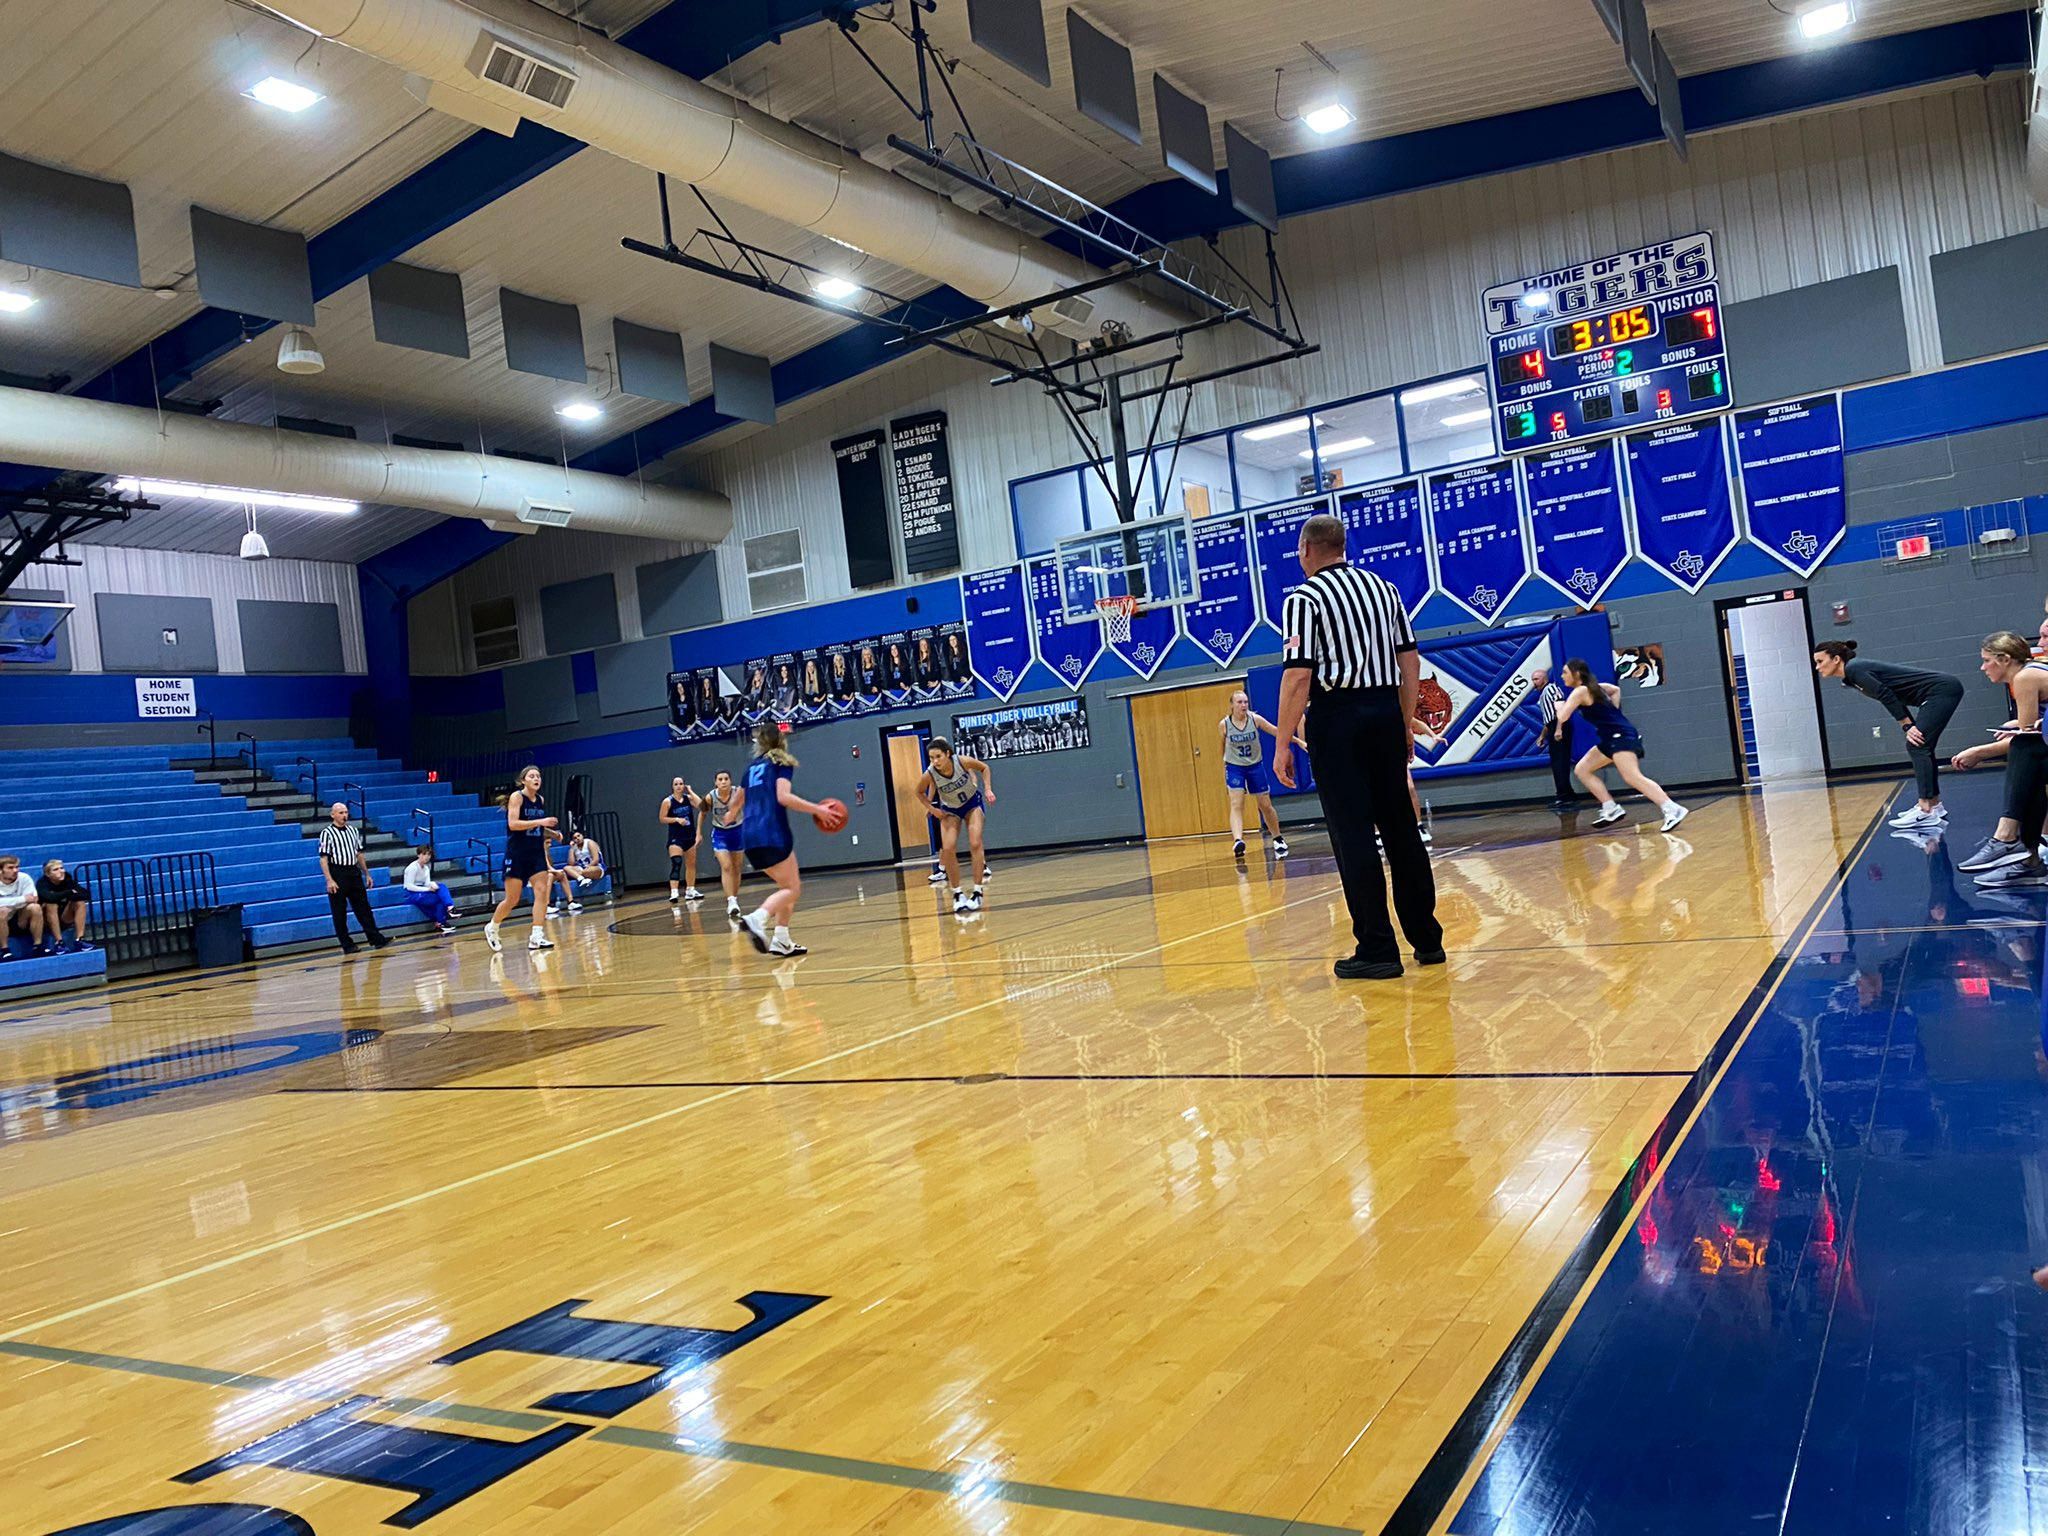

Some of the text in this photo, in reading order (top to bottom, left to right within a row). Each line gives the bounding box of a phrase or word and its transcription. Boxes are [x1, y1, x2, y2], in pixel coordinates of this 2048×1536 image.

[1524, 243, 1675, 295] HOME OF THE
[1489, 243, 1710, 330] TIGERS
[1657, 289, 1714, 313] VISITOR
[1572, 306, 1650, 351] 3:05
[1692, 307, 1716, 338] 7
[1498, 332, 1537, 353] HOME
[1583, 353, 1602, 363] POSS
[1616, 350, 1633, 375] 2
[1661, 347, 1696, 364] BONUS
[1522, 350, 1544, 378] 4
[1578, 359, 1614, 375] PERIOD
[1685, 360, 1718, 376] FOULS
[1520, 380, 1552, 395] BONUS
[1619, 375, 1651, 391] FOULS
[1712, 371, 1722, 396] 1
[1573, 385, 1610, 400] PLAYER
[1657, 389, 1671, 408] 3
[1504, 401, 1533, 417] FOULS
[1655, 408, 1676, 418] TOL
[1768, 404, 1802, 416] SOFTBALL
[1552, 412, 1567, 430] 5
[1764, 410, 1810, 425] AREA CHAMPIONS
[893, 423, 941, 441] LADY TIGERS
[1520, 413, 1536, 437] 3
[1653, 424, 1692, 438] VOLLEYBALL
[894, 434, 937, 450] BASKETBALL
[1551, 430, 1570, 440] TOL
[1649, 431, 1699, 447] STATE TOURNAMENT
[836, 446, 857, 458] GUNTER
[852, 452, 867, 463] BOYS
[1550, 446, 1587, 459] VOLLEYBALL
[1565, 452, 1596, 463] TOURNAMENT
[1810, 445, 1840, 456] CHAMPIONS
[905, 453, 932, 465] ESNARD
[908, 471, 934, 483] TOKARZ
[1454, 467, 1488, 479] VOLLEYBALL
[1472, 473, 1497, 483] CHAMPIONS
[1662, 471, 1696, 483] STATE FINALS
[900, 476, 947, 494] 13 S PUTNICKI
[1584, 487, 1612, 497] CHAMPIONS
[1809, 486, 1840, 497] CHAMPIONS
[900, 488, 940, 503] 20 TARPLEY
[1362, 487, 1394, 498] VOLLEYBALL
[902, 497, 938, 512] 22 ESNARD
[1283, 505, 1314, 516] BASKETBALL
[903, 512, 912, 520] 24
[1661, 509, 1706, 522] STATE CHAMPIONS
[905, 524, 941, 538] 32 ANDRES
[1201, 522, 1231, 533] BASKETBALL
[1471, 525, 1496, 534] CHAMPIONS
[1577, 527, 1604, 537] CHAMPIONS
[1382, 542, 1406, 550] CHAMPIONS
[995, 568, 1013, 576] COUNTRY
[143, 693, 190, 701] STUDENT
[145, 706, 190, 714] SECTION
[1469, 674, 1529, 739] TIGERS
[959, 700, 1078, 729] GUNTER TIGER VOLLEYBALL
[1237, 745, 1251, 757] 32
[748, 763, 766, 787] 12
